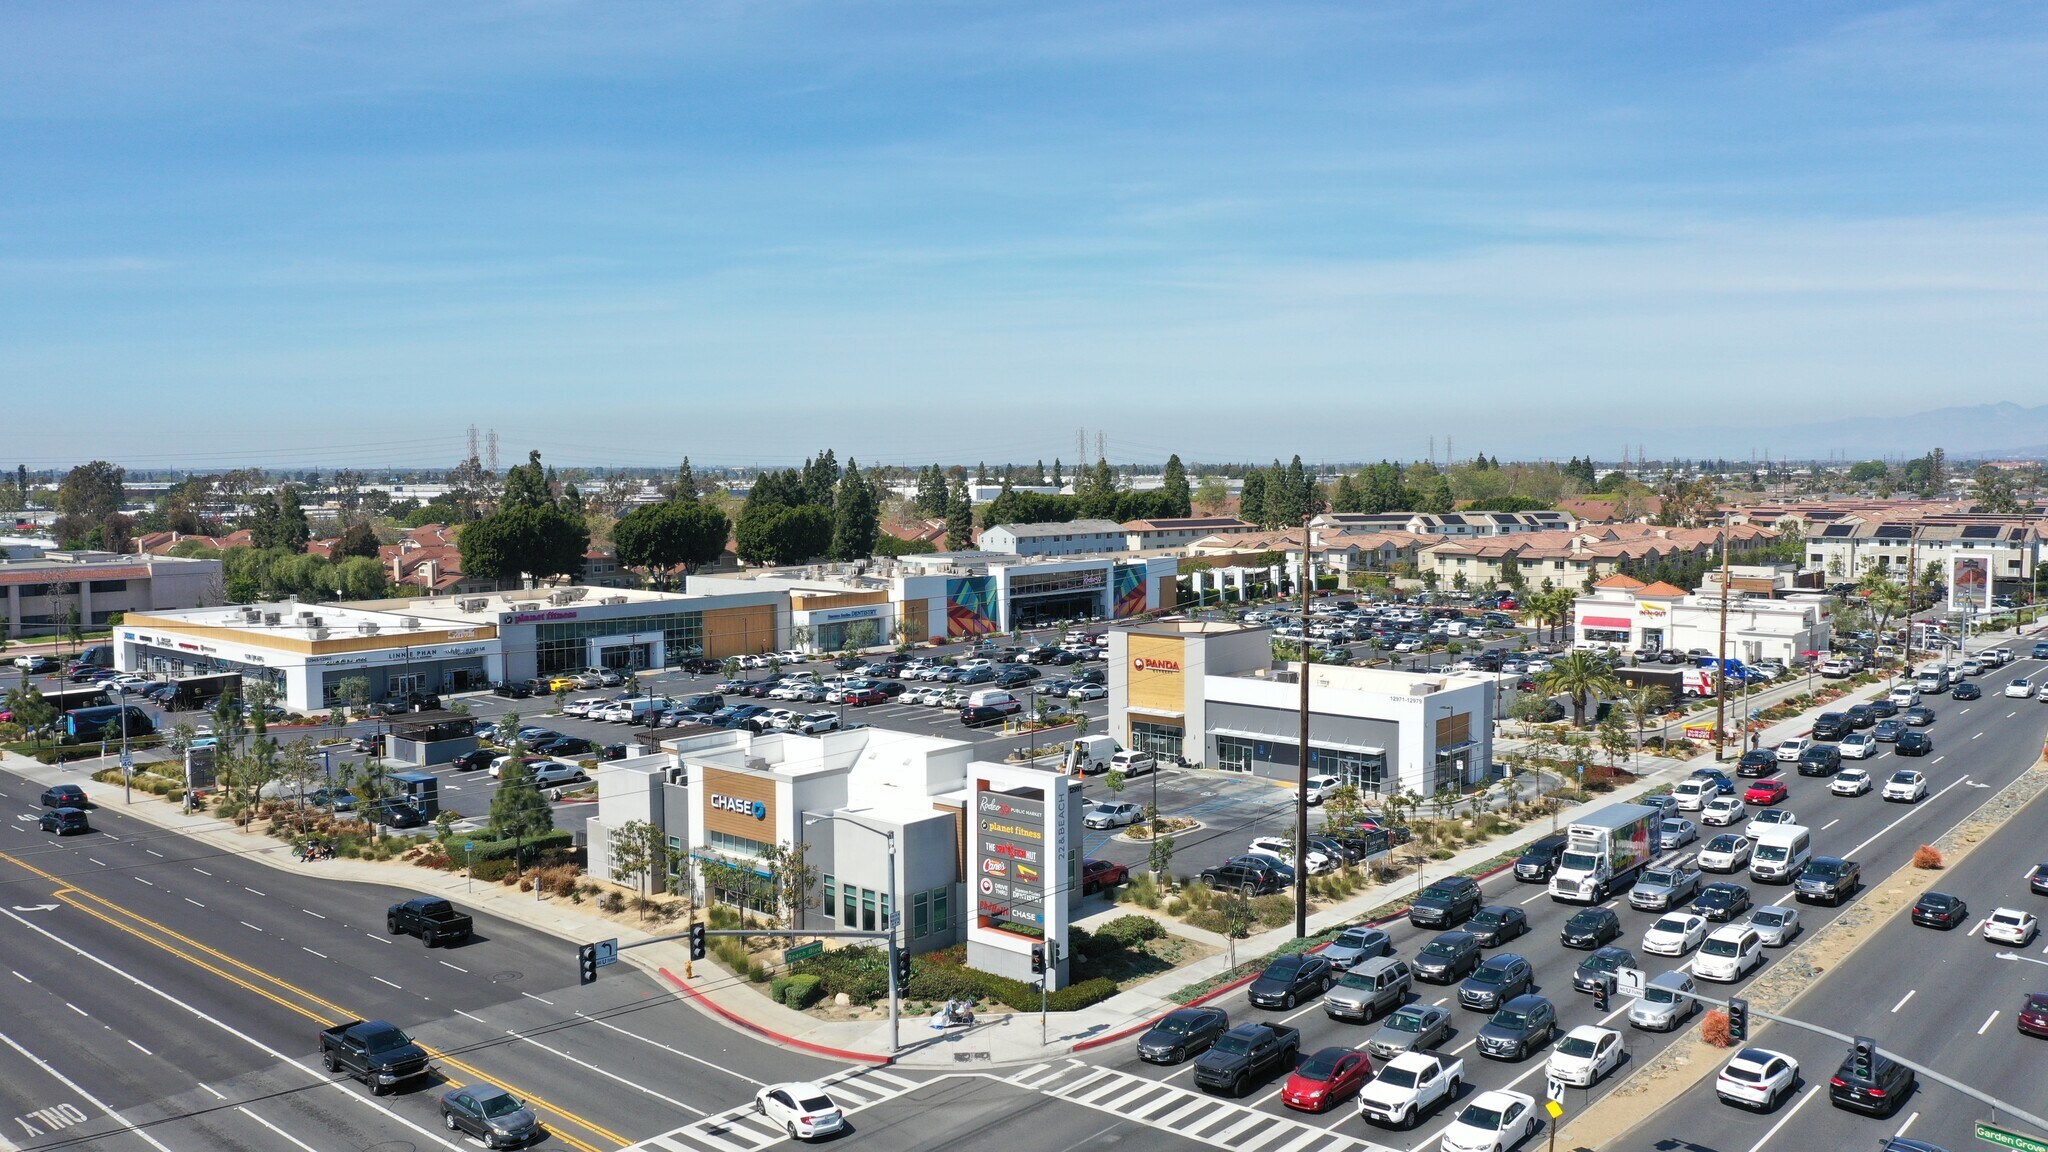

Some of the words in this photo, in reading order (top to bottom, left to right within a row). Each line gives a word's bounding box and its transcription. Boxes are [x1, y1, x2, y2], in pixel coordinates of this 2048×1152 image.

[514, 613, 545, 624] planet
[546, 611, 577, 620] fitness
[389, 650, 413, 660] LINNE
[417, 649, 437, 657] PHAN
[1145, 659, 1180, 671] PANDA
[711, 794, 752, 815] CHASE
[1011, 807, 1026, 815] PUBLIC
[1026, 810, 1042, 818] MARKET
[989, 822, 1014, 834] planet
[1015, 825, 1041, 839] fitness
[986, 842, 996, 852] THE
[1025, 850, 1036, 861] HUT
[983, 858, 1006, 873] Cane's
[994, 882, 1008, 891] DRIVE
[1012, 909, 1036, 921] CHASE
[787, 951, 807, 961] Beach
[14, 1103, 88, 1138] ONLY
[1977, 1127, 2014, 1145] Garden
[2015, 1138, 2046, 1152] Grove
